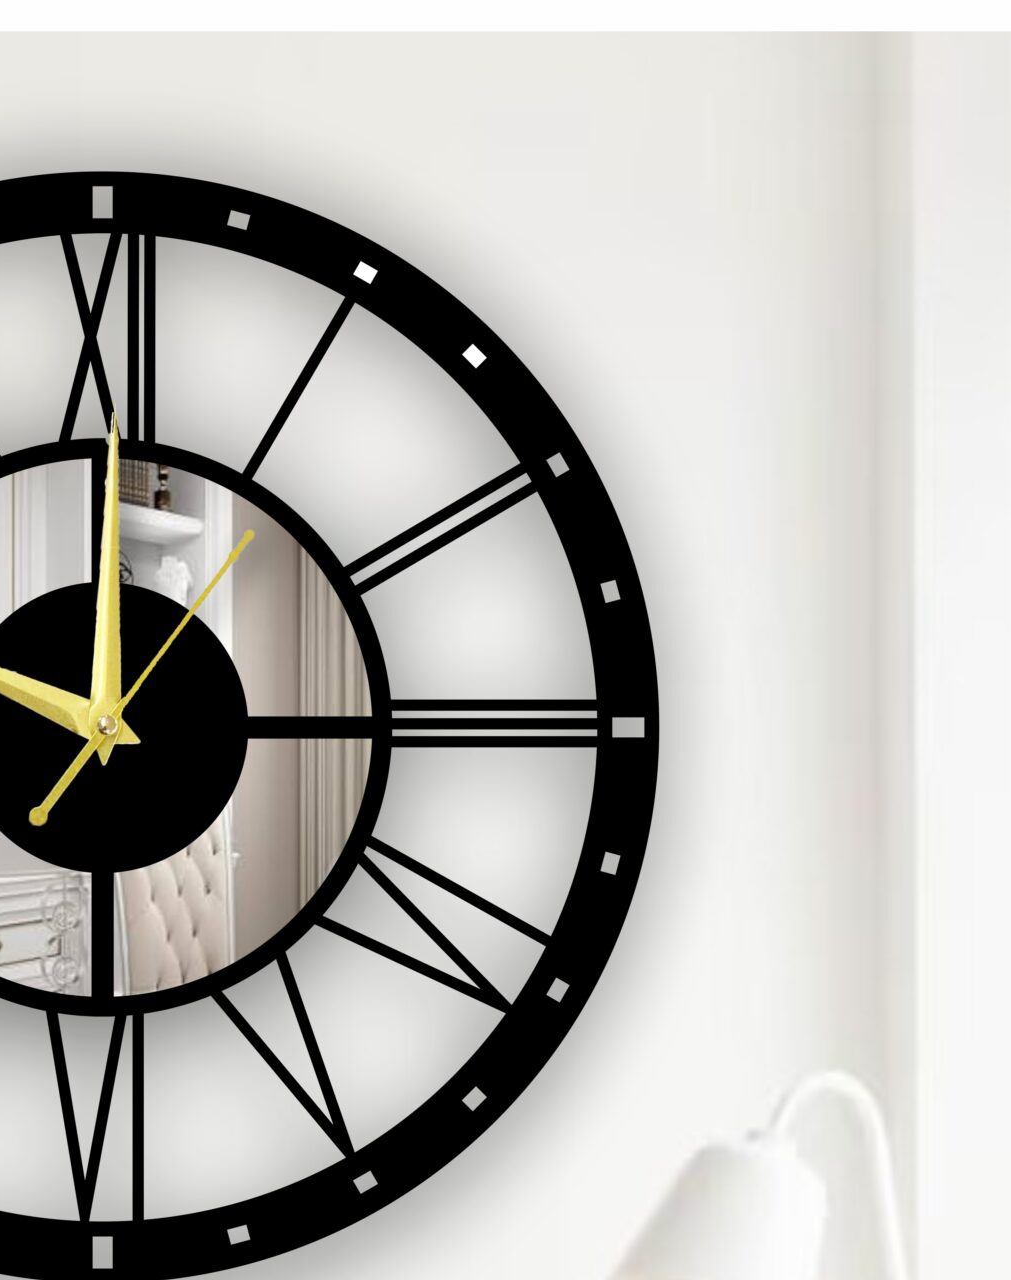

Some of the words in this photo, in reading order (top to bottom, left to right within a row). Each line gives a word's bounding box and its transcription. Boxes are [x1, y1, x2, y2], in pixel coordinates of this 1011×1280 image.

[59, 233, 156, 443] XII
[243, 296, 355, 479] I
[343, 462, 539, 596] II
[391, 699, 597, 748] III
[46, 1012, 144, 1221] VI
[210, 951, 355, 1157] V
